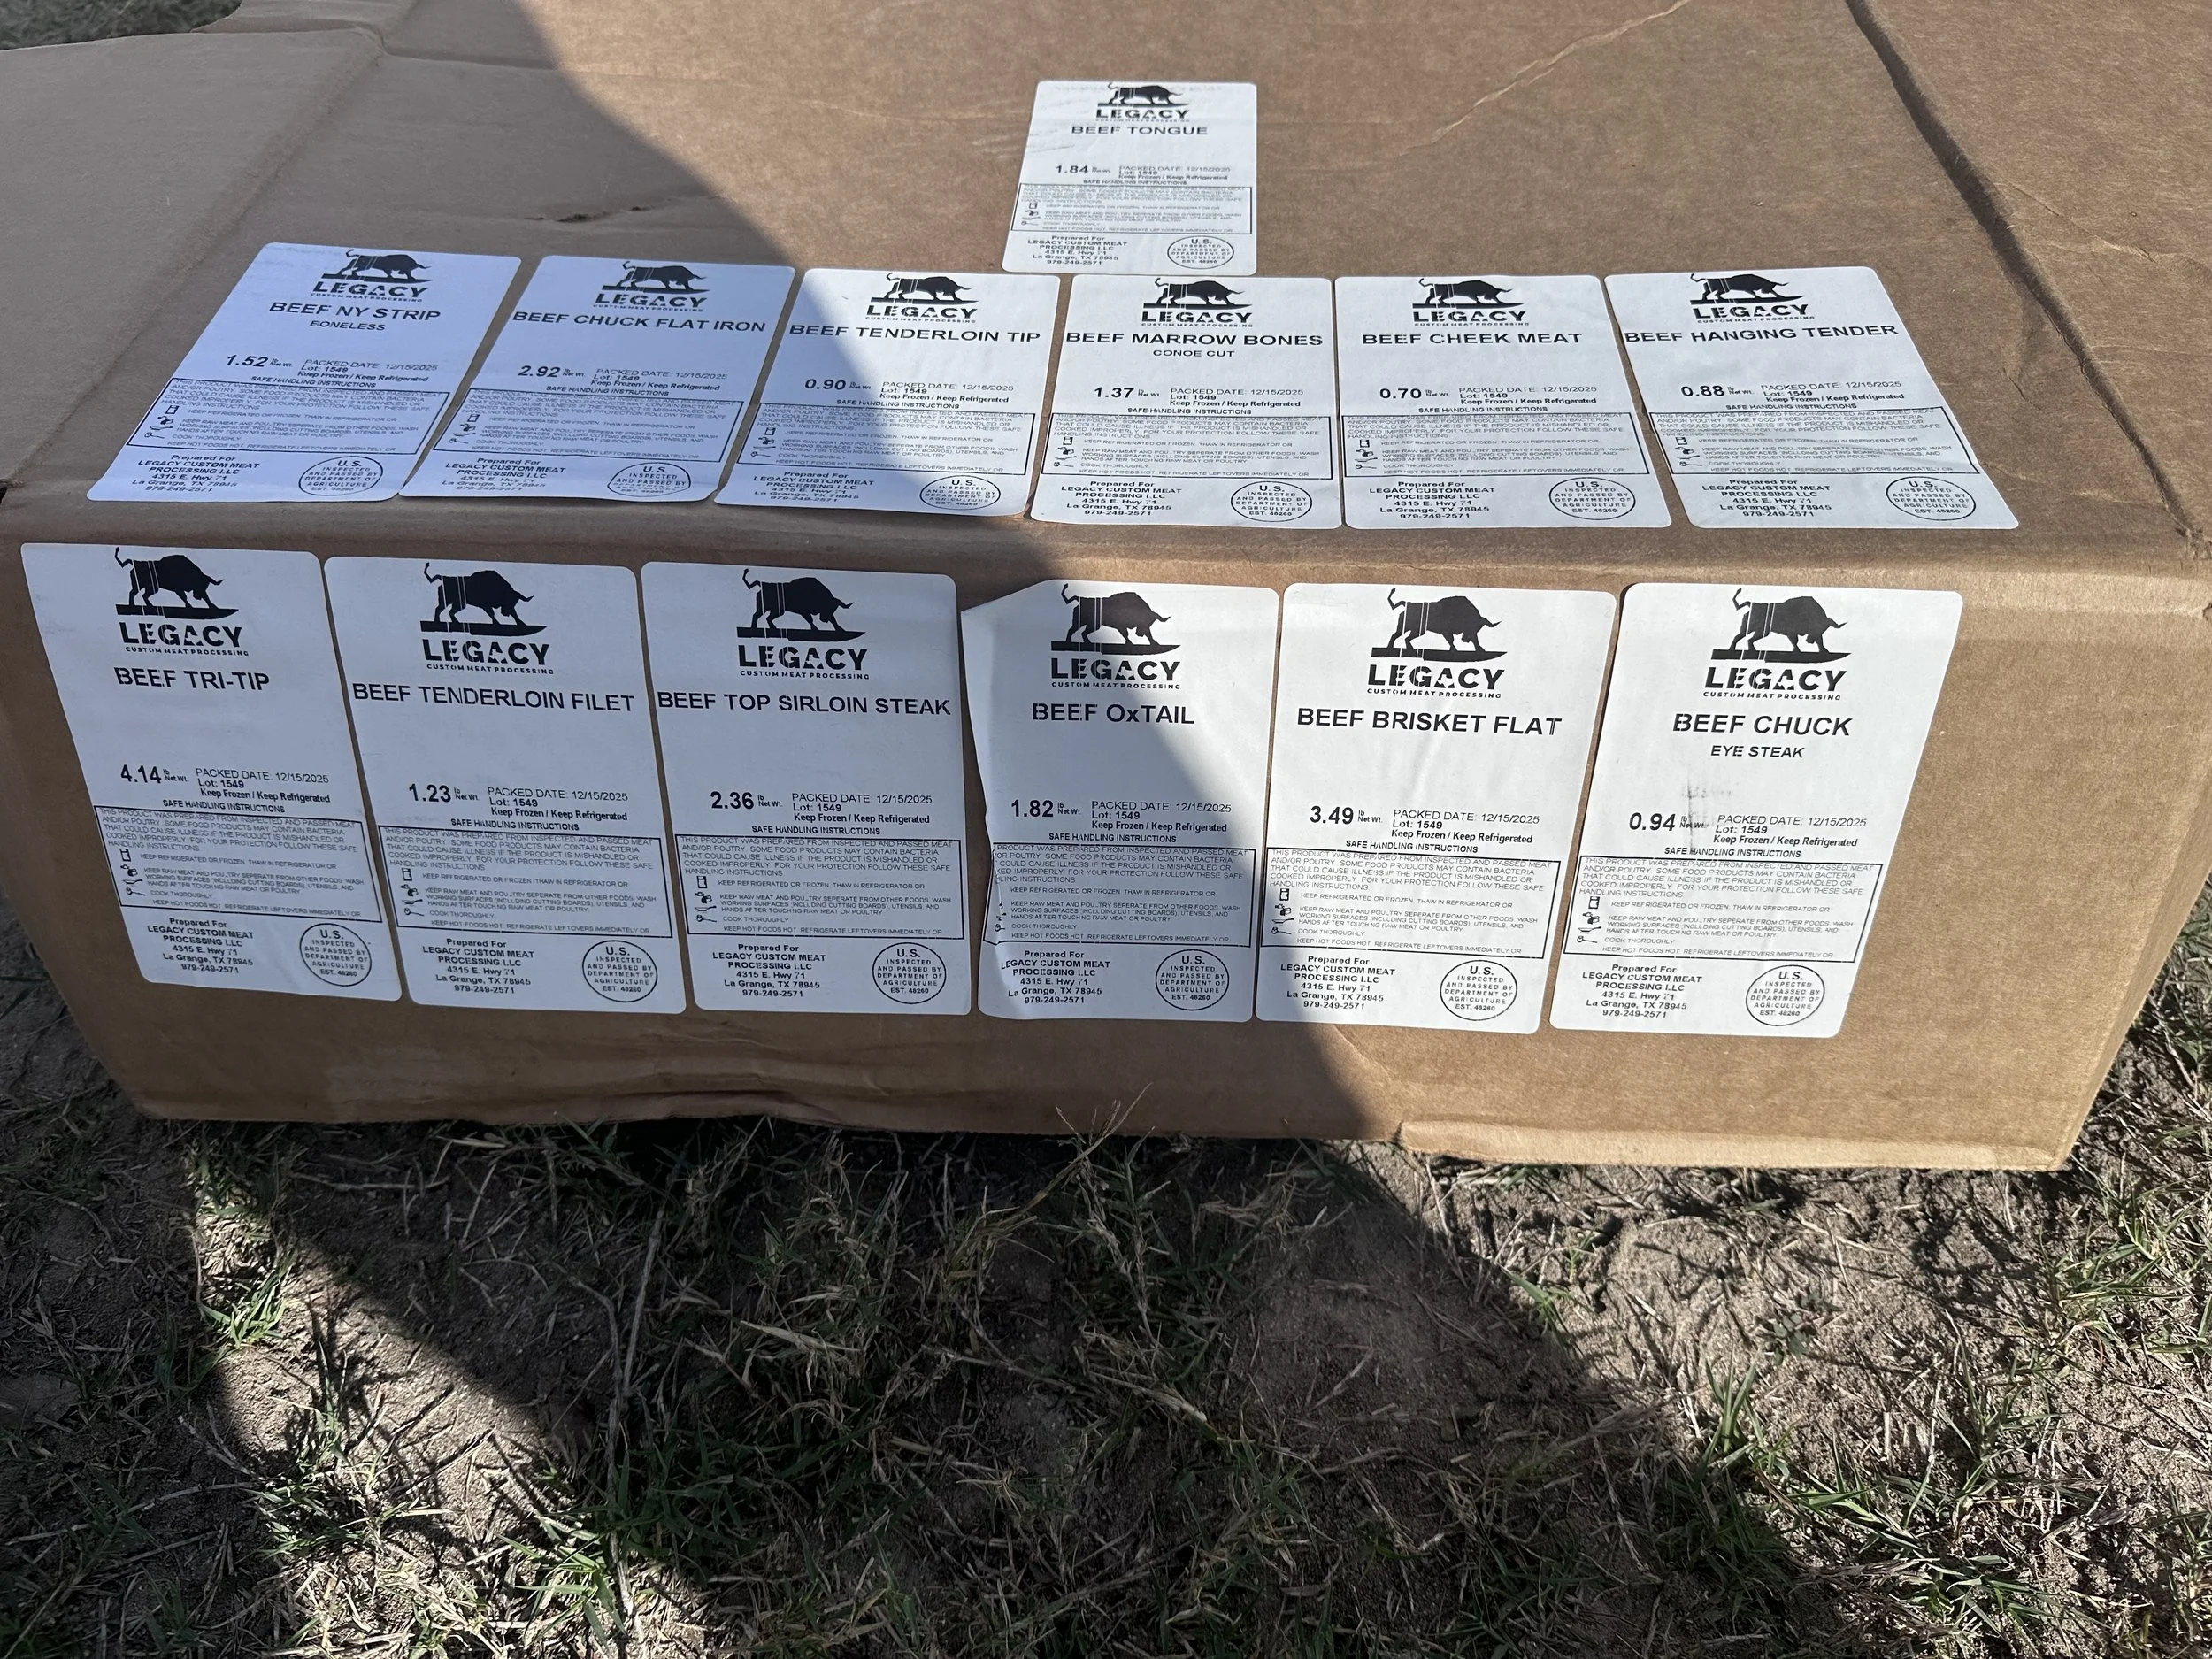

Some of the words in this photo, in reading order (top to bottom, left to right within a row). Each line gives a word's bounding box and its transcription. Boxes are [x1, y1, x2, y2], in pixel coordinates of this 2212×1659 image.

[1095, 109, 1188, 119] LEGACY
[1071, 126, 1120, 134] BEEF
[1126, 126, 1207, 135] TONGUE
[1056, 165, 1088, 173] 1.84
[312, 281, 427, 297] LEGACY
[595, 293, 707, 308] LEGACY
[268, 301, 332, 314] BEEF
[335, 305, 370, 317] NY
[372, 307, 441, 320] STRIP
[866, 304, 977, 319] LEGACY
[1141, 311, 1252, 323] LEGACY
[1413, 311, 1525, 322] LEGACY
[1693, 303, 1808, 319] LEGACY
[309, 319, 386, 331] BONELESS
[511, 311, 570, 323] BEEF
[573, 314, 650, 327] CHUCK
[655, 318, 710, 329] FLAT
[713, 320, 766, 332] IRON
[788, 324, 849, 336] BEEF
[856, 326, 999, 342] TENDERLOIN
[1007, 332, 1041, 342] TIP
[1065, 332, 1125, 343] BEEF
[1132, 333, 1237, 345] MARROW
[1243, 334, 1323, 346] BONES
[1362, 334, 1422, 344] BEEF
[1429, 333, 1511, 344] CHEEK
[1517, 333, 1582, 343] MEAT
[1624, 332, 1683, 342] BEEF
[1690, 328, 1797, 342] HANGING
[1801, 325, 1900, 337] TENDER
[227, 354, 269, 367] 1.52
[517, 365, 561, 378] 2.92
[804, 378, 846, 390] 0.90
[1680, 385, 1725, 396] 0.88
[1094, 387, 1134, 398] 1.37
[1379, 388, 1422, 399] 0.70
[119, 621, 242, 648] LEGACY
[422, 638, 549, 665] LEGACY
[738, 644, 867, 671] LEGACY
[1051, 657, 1180, 681] LEGACY
[113, 666, 176, 687] BEEF
[182, 670, 270, 691] TRI-TIP
[1368, 664, 1505, 690] LEGACY
[1704, 666, 1847, 691] LEGACY
[351, 682, 411, 702] BEEF
[417, 686, 565, 709] TENDERLOIN
[571, 692, 634, 711] FILET
[657, 691, 716, 709] BEEF
[723, 694, 771, 710] TOP
[778, 695, 868, 713] SIRLOIN
[875, 697, 951, 715] STEAK
[1032, 703, 1098, 721] BEEF
[1106, 703, 1194, 724] OxTAIL
[1297, 707, 1364, 727] BEEF
[1371, 710, 1486, 733] BRISKET
[1493, 715, 1563, 735] FLAT
[1672, 713, 1746, 733] BEEF
[1753, 715, 1853, 736] CHUCK
[1710, 744, 1745, 757] EYE
[1747, 746, 1805, 758] STEAK
[120, 764, 162, 784] 4.14
[195, 767, 239, 779] PACKED
[275, 772, 329, 783] 12/15/2025
[219, 779, 244, 788] 1549
[408, 783, 451, 803] 1.23
[487, 787, 533, 797] PACKED
[572, 790, 628, 801] 12/15/2025
[792, 793, 838, 803] PACKED
[876, 795, 933, 804] 12/15/2025
[512, 797, 538, 807] 1549
[710, 791, 754, 810] 2.36
[1091, 800, 1137, 810] PACKED
[1176, 803, 1231, 812] 12/15/2025
[817, 803, 841, 812] 1549
[1011, 799, 1054, 818] 1.82
[1115, 810, 1140, 820] 1549
[1310, 805, 1354, 825] 3.49
[1393, 809, 1440, 819] PACKED
[1481, 813, 1540, 824] 12/15/2025
[1717, 814, 1767, 825] PACKED
[1809, 817, 1866, 826] 12/15/2025
[473, 819, 517, 829] HANDLING
[518, 821, 580, 831] INSTRUCTIONS
[1417, 820, 1442, 829] 1549
[1629, 812, 1676, 832] 0.94
[775, 826, 818, 834] HANDLING
[819, 826, 880, 835] INSTRUCTIONS
[1346, 840, 1367, 849] SAFE
[1415, 843, 1478, 853] INSTRUCTIONS
[1689, 847, 1735, 856] HANDLING
[1737, 849, 1801, 857] INSTRUCTIONS
[180, 963, 239, 973] 979-249-2571
[454, 984, 514, 994] 979-249-2571
[741, 988, 803, 997] 979-249-2571
[1024, 994, 1084, 1004] 979-249-2571
[1303, 1000, 1364, 1010] 979-249-2571
[1602, 1009, 1666, 1018] 979-249-2571
